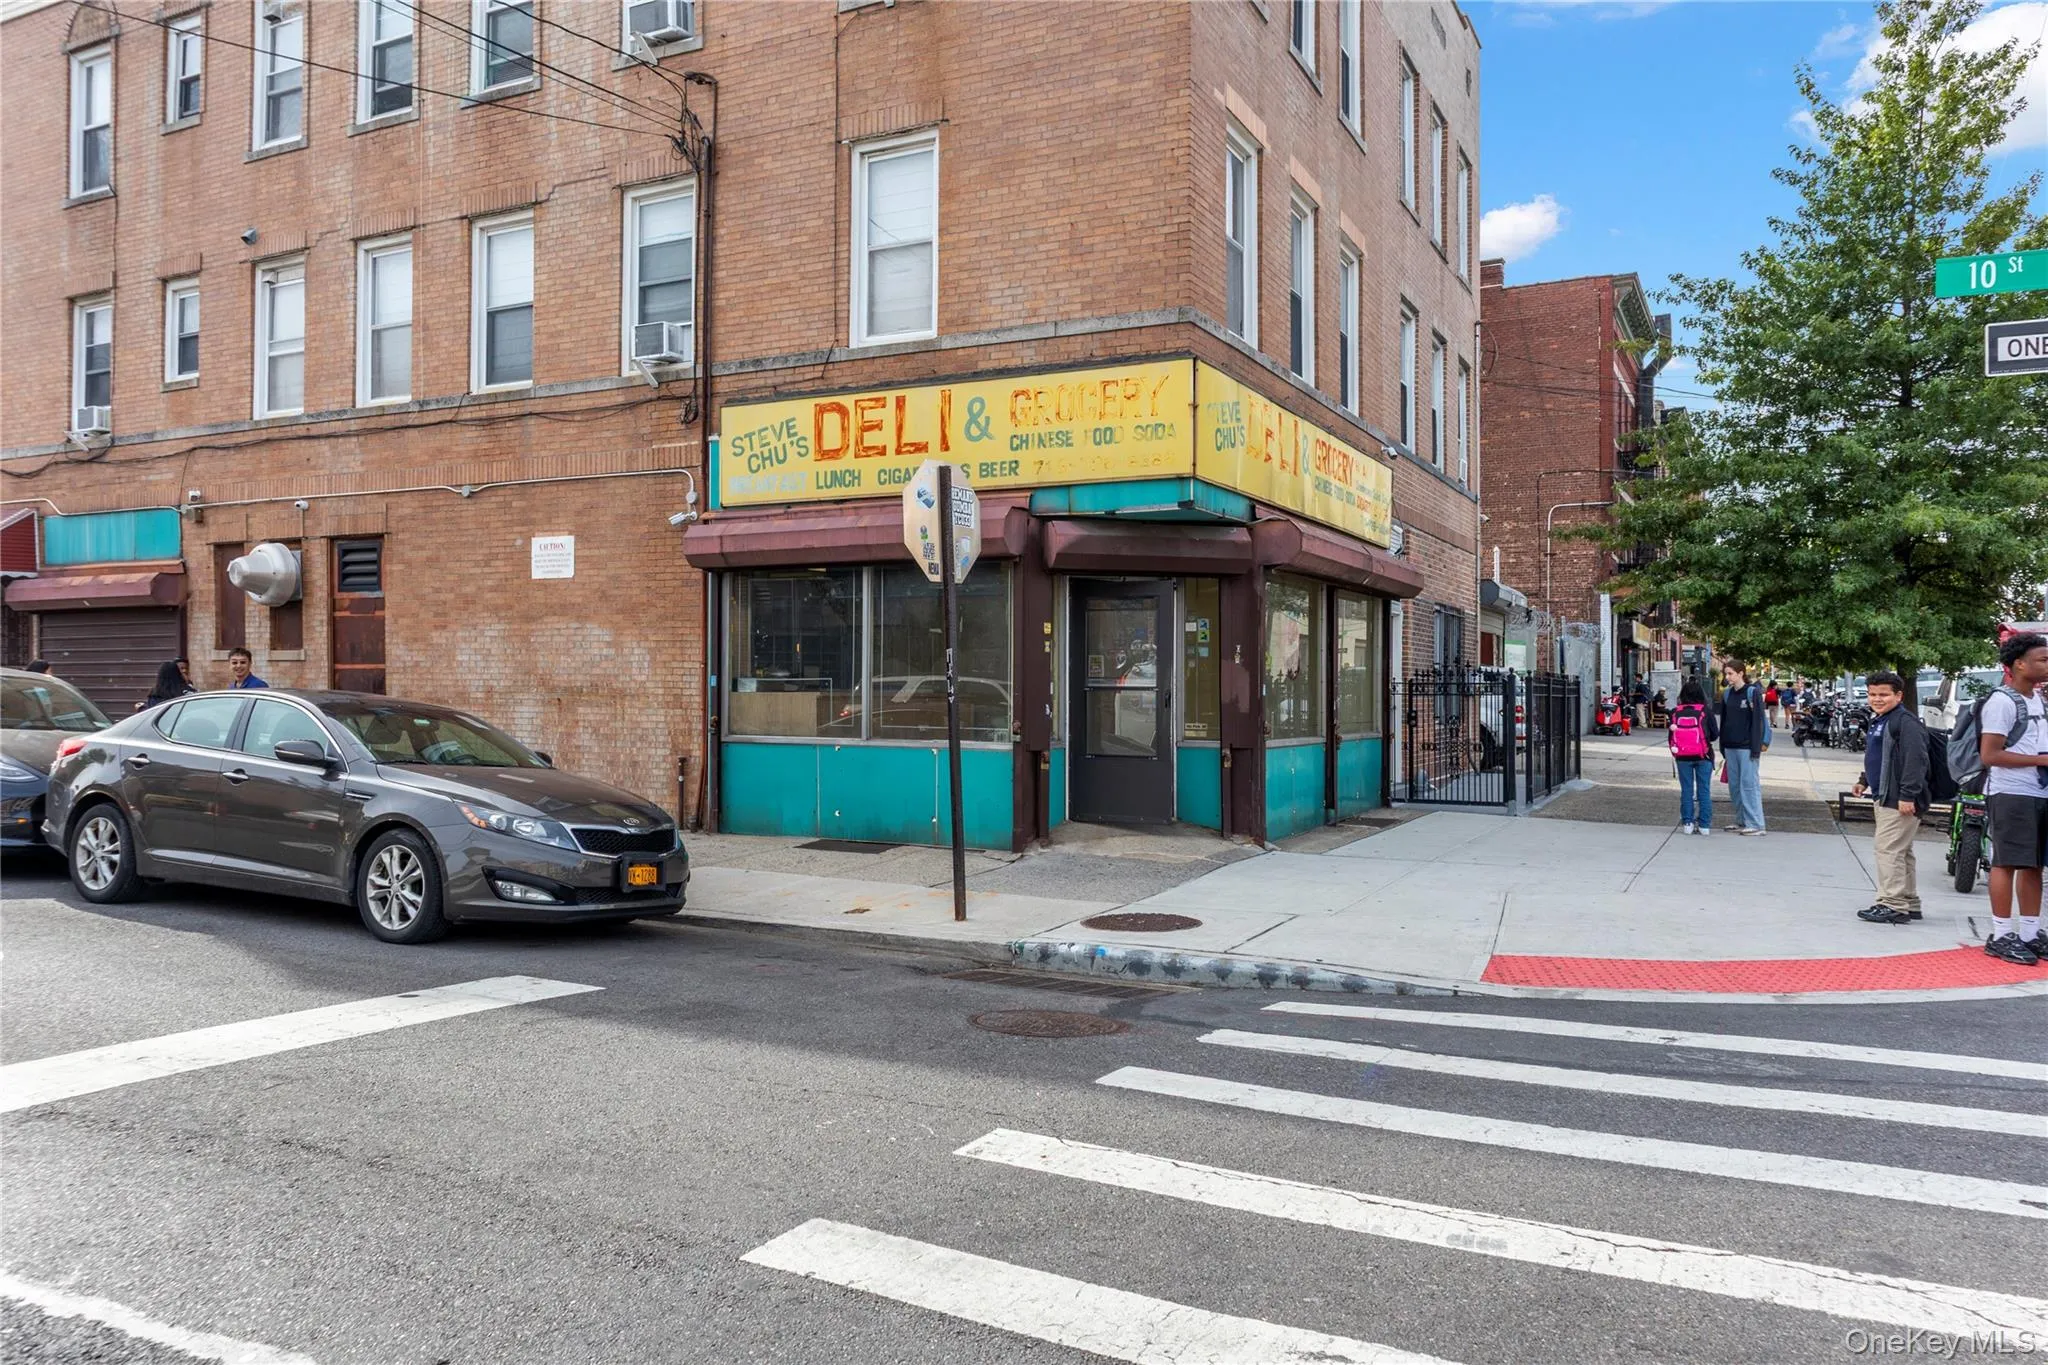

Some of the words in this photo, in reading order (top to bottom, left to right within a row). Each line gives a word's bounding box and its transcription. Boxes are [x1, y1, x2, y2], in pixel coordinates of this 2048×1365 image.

[1969, 260, 1997, 289] 10
[2008, 256, 2024, 273] St
[2007, 336, 2048, 358] ONE
[813, 389, 951, 462] DELI
[964, 396, 995, 443] &
[1010, 375, 1170, 428] GROCERY
[731, 417, 798, 457] STEVE
[1010, 430, 1074, 451] CHINESE
[1132, 422, 1177, 443] SODA
[1214, 425, 1246, 452] CHU'S
[747, 436, 809, 474] CHU'S
[1315, 438, 1354, 489] GROCERY
[816, 469, 861, 490] LUNCH
[877, 463, 971, 486] CIGAS
[978, 459, 1019, 480] BEER
